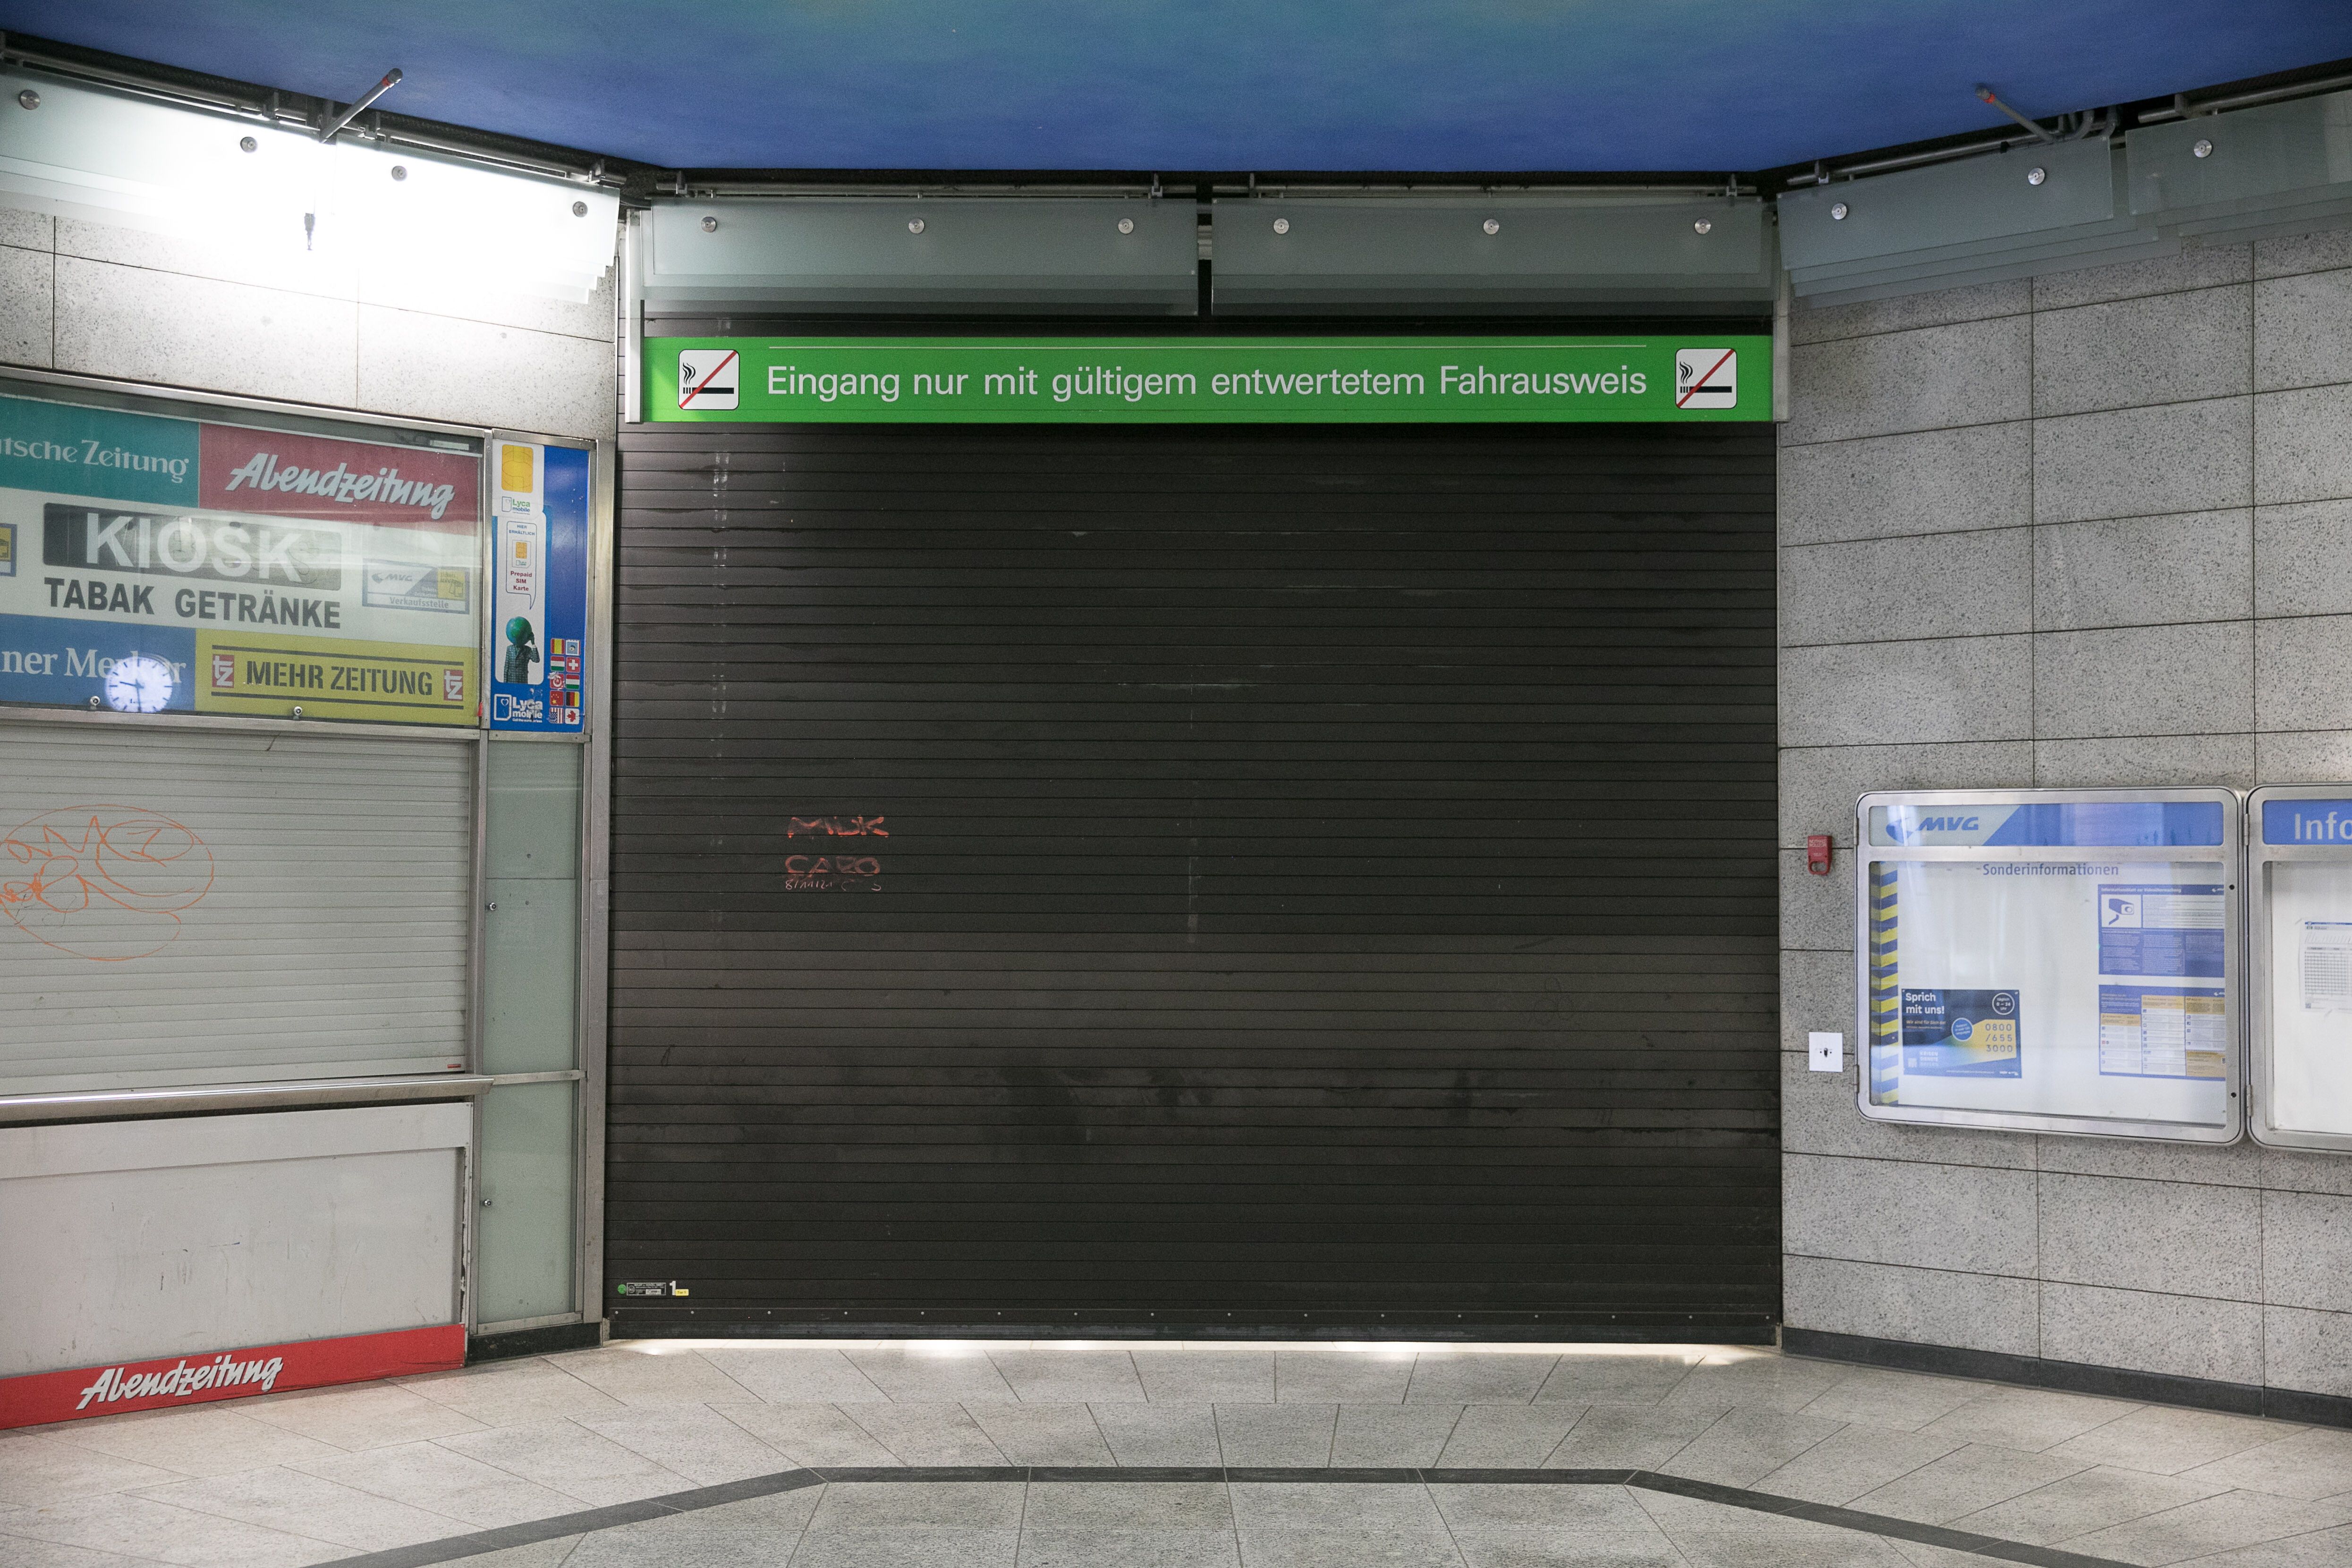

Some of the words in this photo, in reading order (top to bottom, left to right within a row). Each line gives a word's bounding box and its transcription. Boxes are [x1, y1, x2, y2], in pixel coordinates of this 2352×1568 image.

[768, 366, 900, 402] Eingang
[914, 372, 968, 395] nur
[985, 366, 1038, 395] mit
[1053, 365, 1196, 402] gültigem
[1212, 368, 1424, 395] entwertetem
[1441, 365, 1647, 395] Fahrausweis
[0, 438, 77, 463] tsche
[81, 440, 189, 483] Zeitung
[226, 452, 455, 520] Abendzeitung
[512, 499, 530, 508] Lyca
[86, 512, 302, 582] KIOSK
[383, 573, 413, 582] MVG
[44, 577, 155, 615] TABAK
[175, 589, 341, 629] GETRÄNKE
[390, 597, 449, 609] Verkaufsstelle
[213, 657, 234, 687] tz
[247, 661, 324, 689] MEHR
[331, 666, 433, 695] ZEITUNG
[444, 671, 463, 700] tz
[512, 697, 543, 711] Lyca
[1916, 817, 1978, 831] MVG
[2295, 812, 2352, 840] Info
[1983, 863, 2119, 875] Sonderinformationen
[1906, 992, 1936, 1003] Sprich
[1906, 1004, 1922, 1014] mit
[1925, 1006, 1944, 1014] uns!
[670, 1280, 676, 1296] 1
[76, 1354, 283, 1410] Abendzeitung
